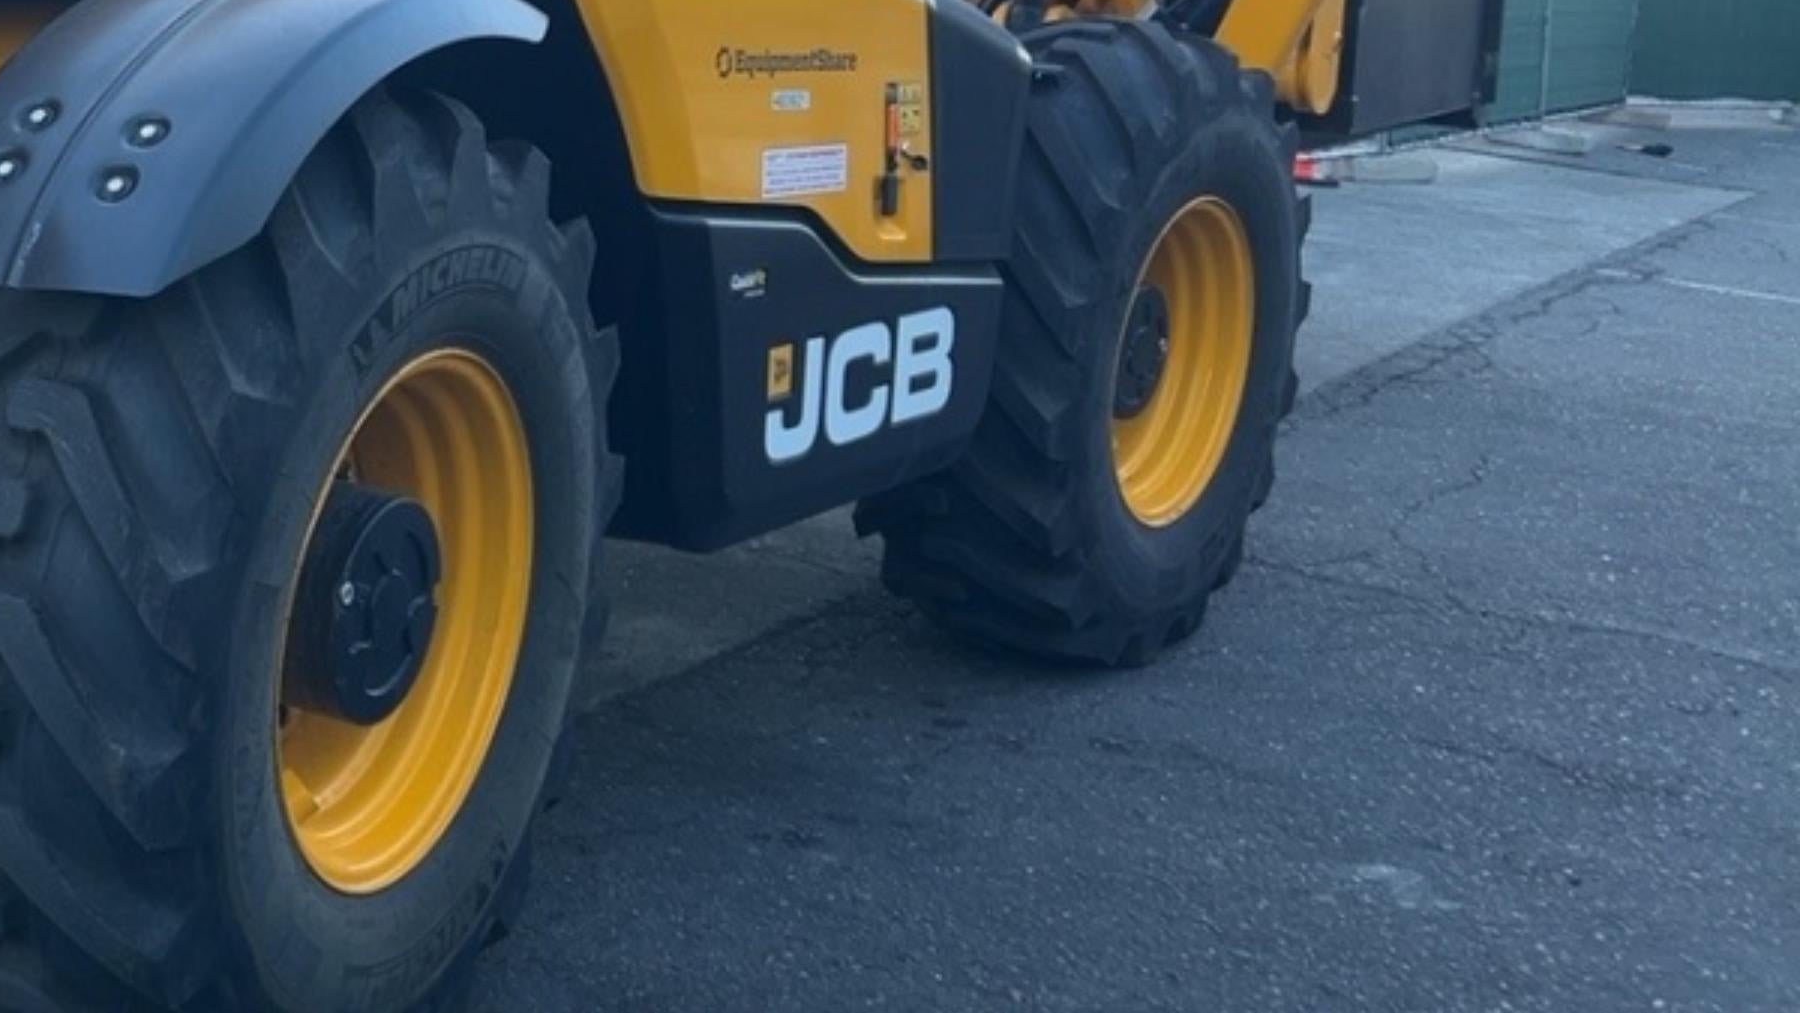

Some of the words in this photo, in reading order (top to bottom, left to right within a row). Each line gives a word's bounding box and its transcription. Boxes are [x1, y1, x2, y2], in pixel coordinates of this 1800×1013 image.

[735, 49, 857, 79] EquipmentShare
[391, 246, 528, 324] MICHELIN
[764, 306, 955, 466] JCB
